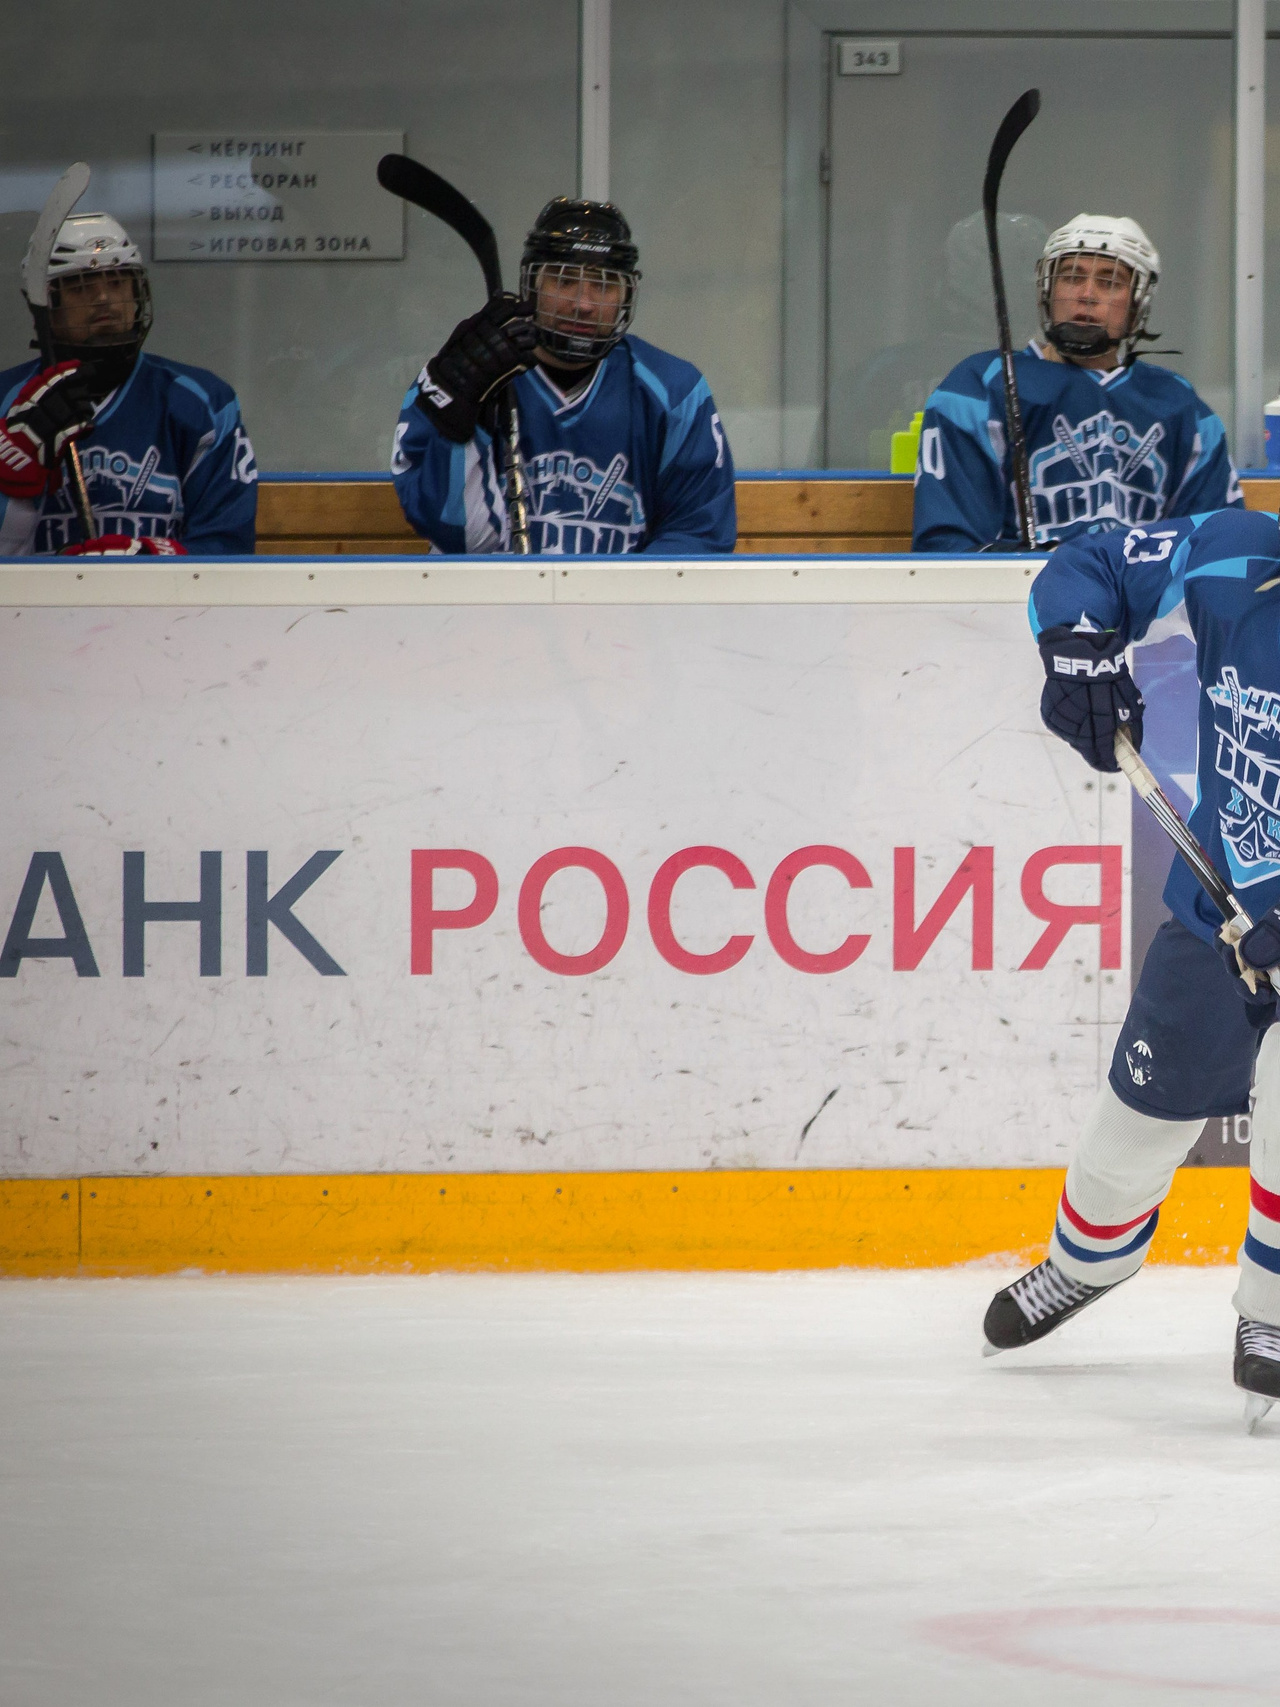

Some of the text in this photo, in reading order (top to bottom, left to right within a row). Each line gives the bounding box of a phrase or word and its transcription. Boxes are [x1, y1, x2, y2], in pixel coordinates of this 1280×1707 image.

[209, 139, 306, 158] КЁРЛИНГ
[209, 173, 318, 189] РЕСТОРАН
[209, 205, 285, 222] ВЫХОД
[209, 235, 371, 252] ИГРОВАЯ ЗОНА
[0, 844, 1124, 978] АНК РОССИЯ
